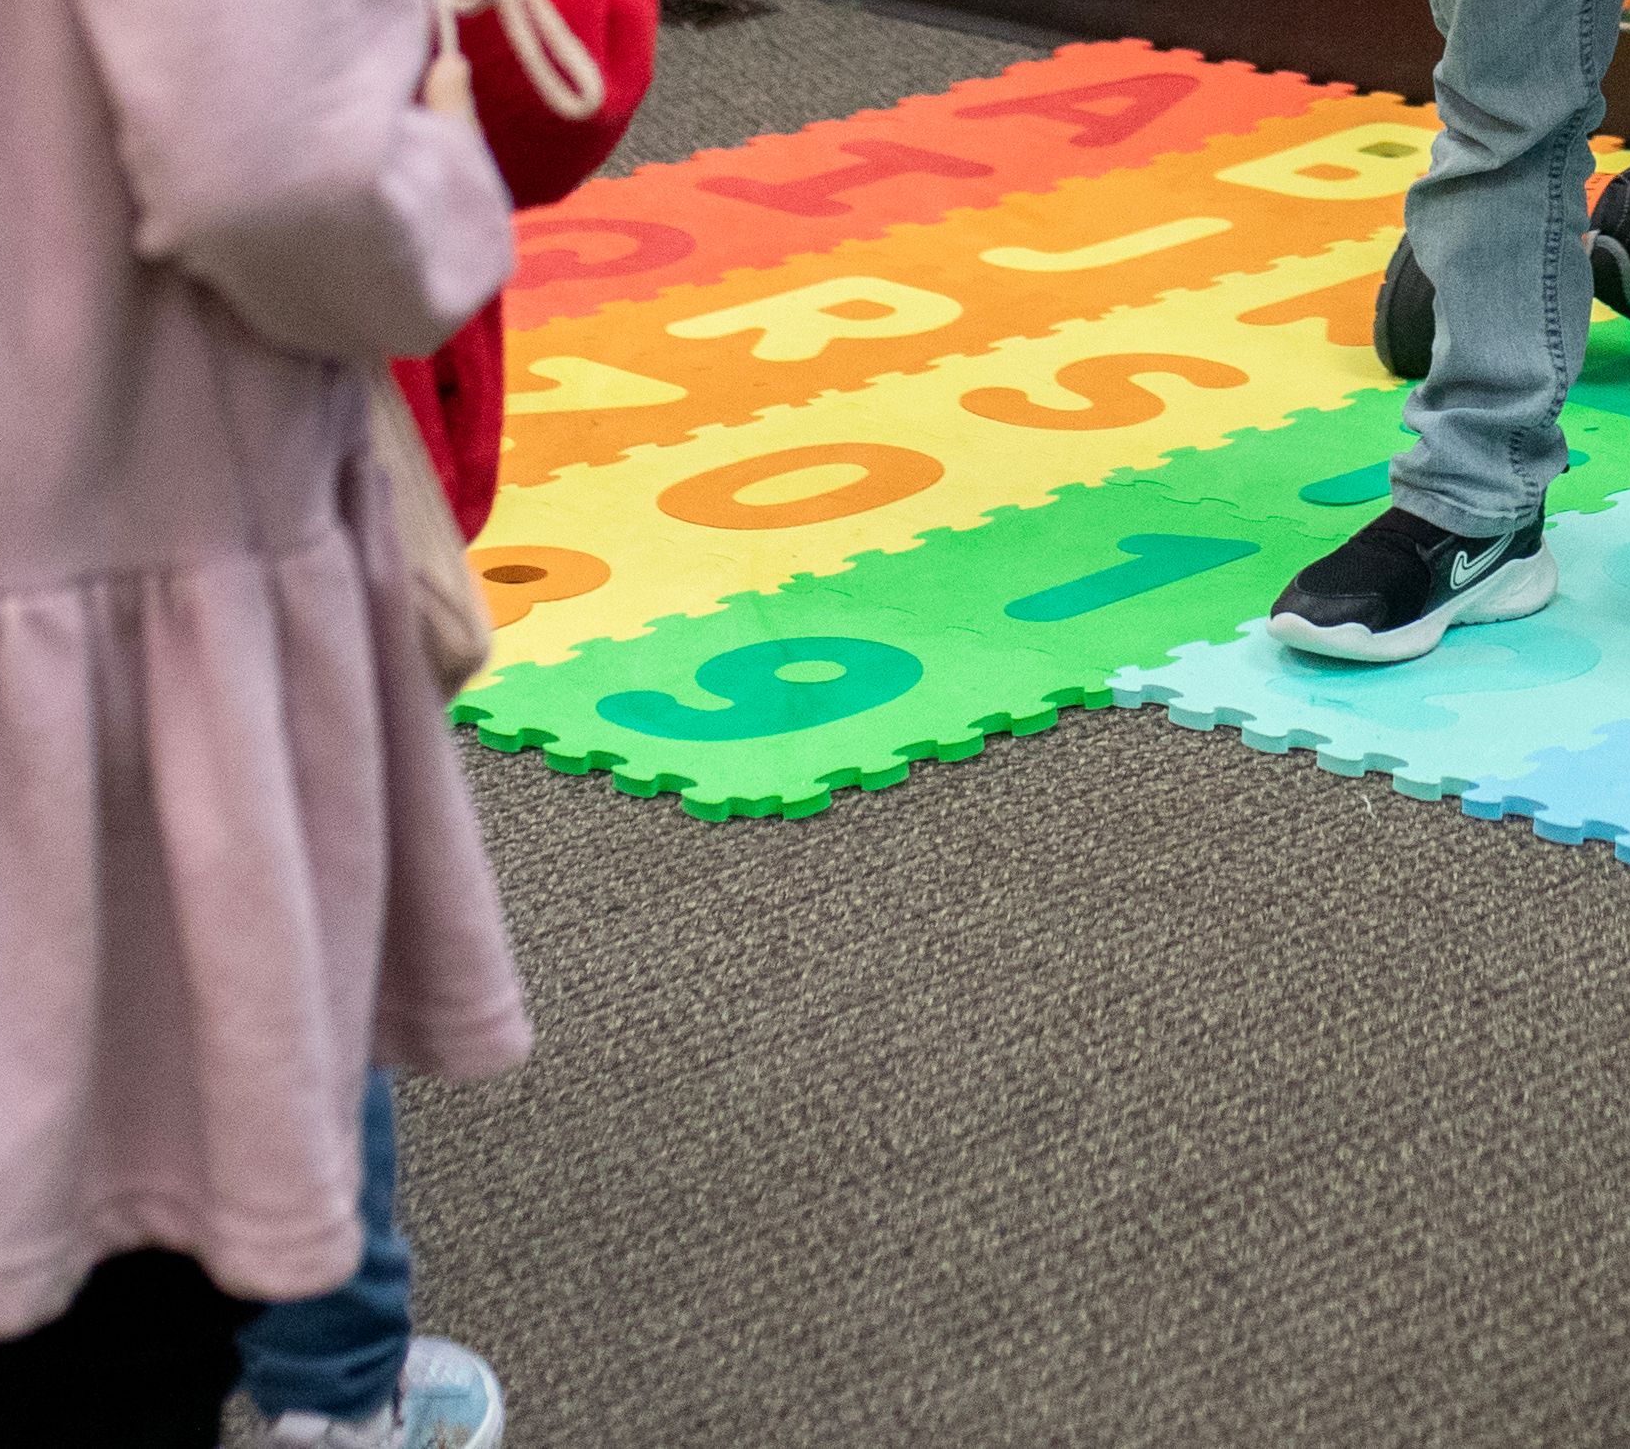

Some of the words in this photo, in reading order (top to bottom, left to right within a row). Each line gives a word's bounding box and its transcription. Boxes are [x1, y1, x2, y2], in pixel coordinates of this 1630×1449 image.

[953, 74, 1202, 146] A
[979, 217, 1231, 271] J
[665, 275, 963, 362] R
[960, 353, 1248, 431] S
